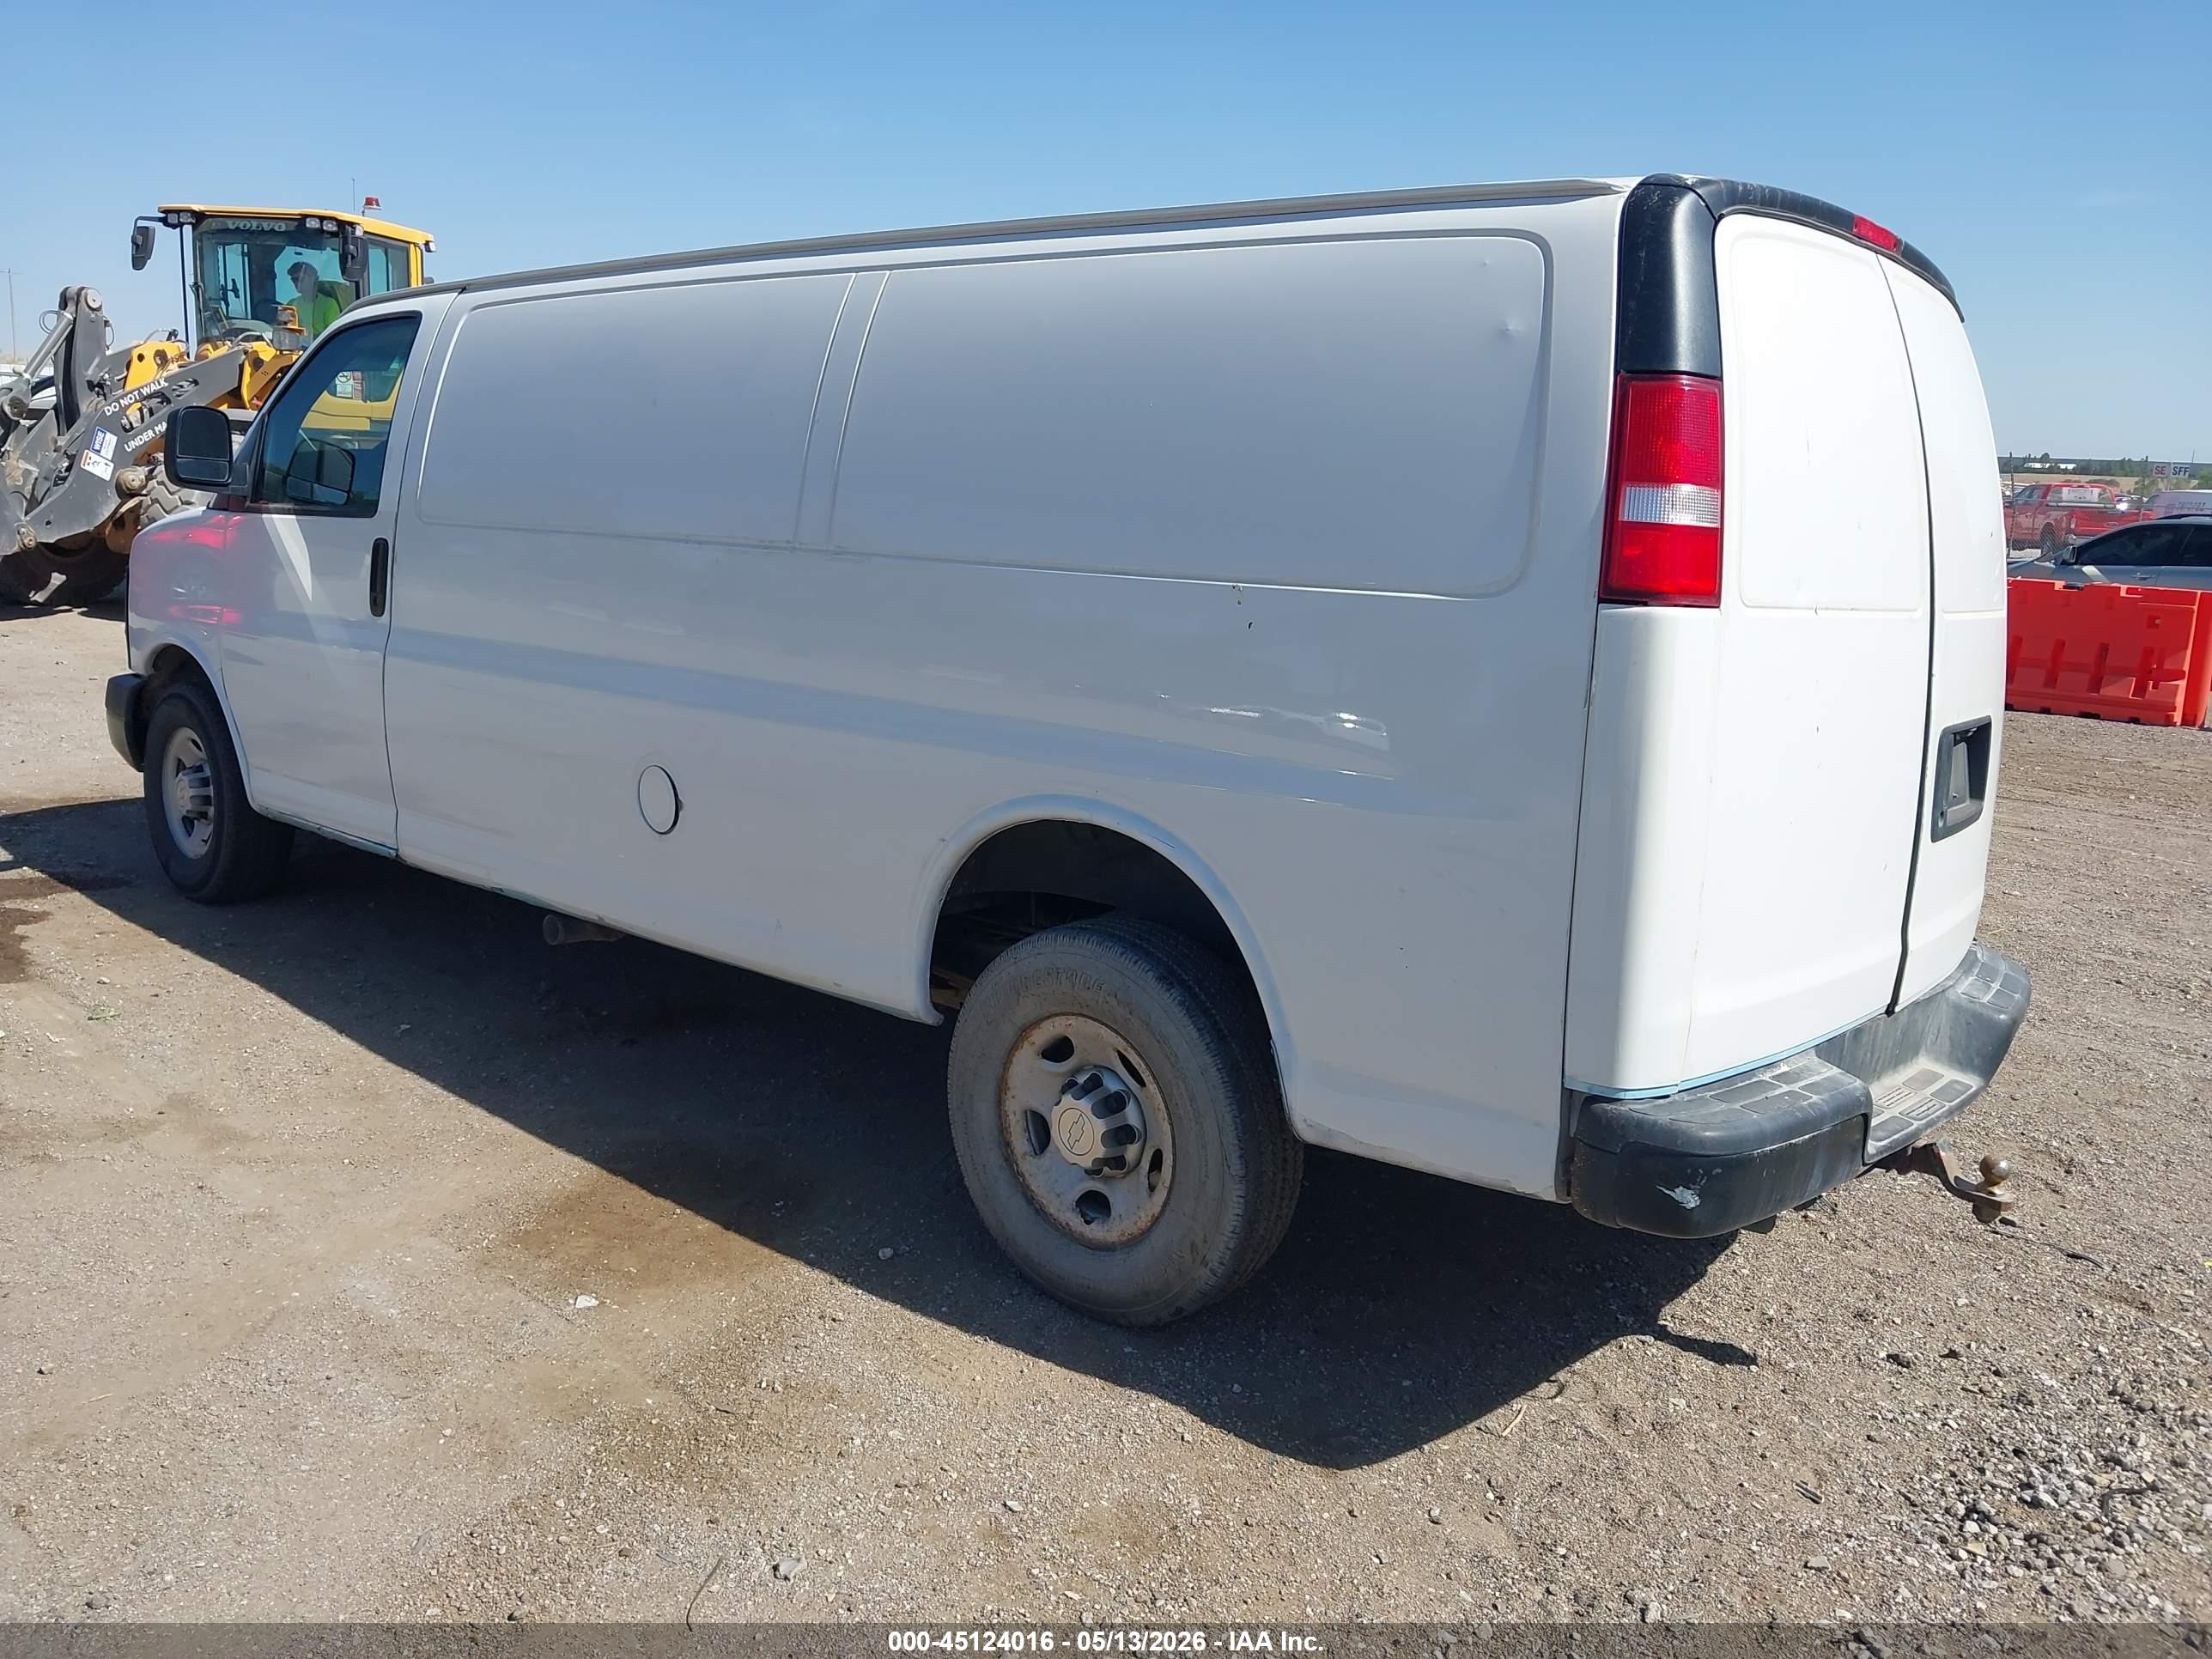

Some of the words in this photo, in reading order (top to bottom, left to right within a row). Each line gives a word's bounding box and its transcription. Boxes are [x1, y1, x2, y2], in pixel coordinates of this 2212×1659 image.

[226, 220, 286, 232] VOLVO
[104, 402, 119, 416] DO
[119, 391, 140, 408] NOT
[139, 377, 169, 396] WALK
[93, 430, 105, 452] WISE
[124, 428, 155, 453] UNDER
